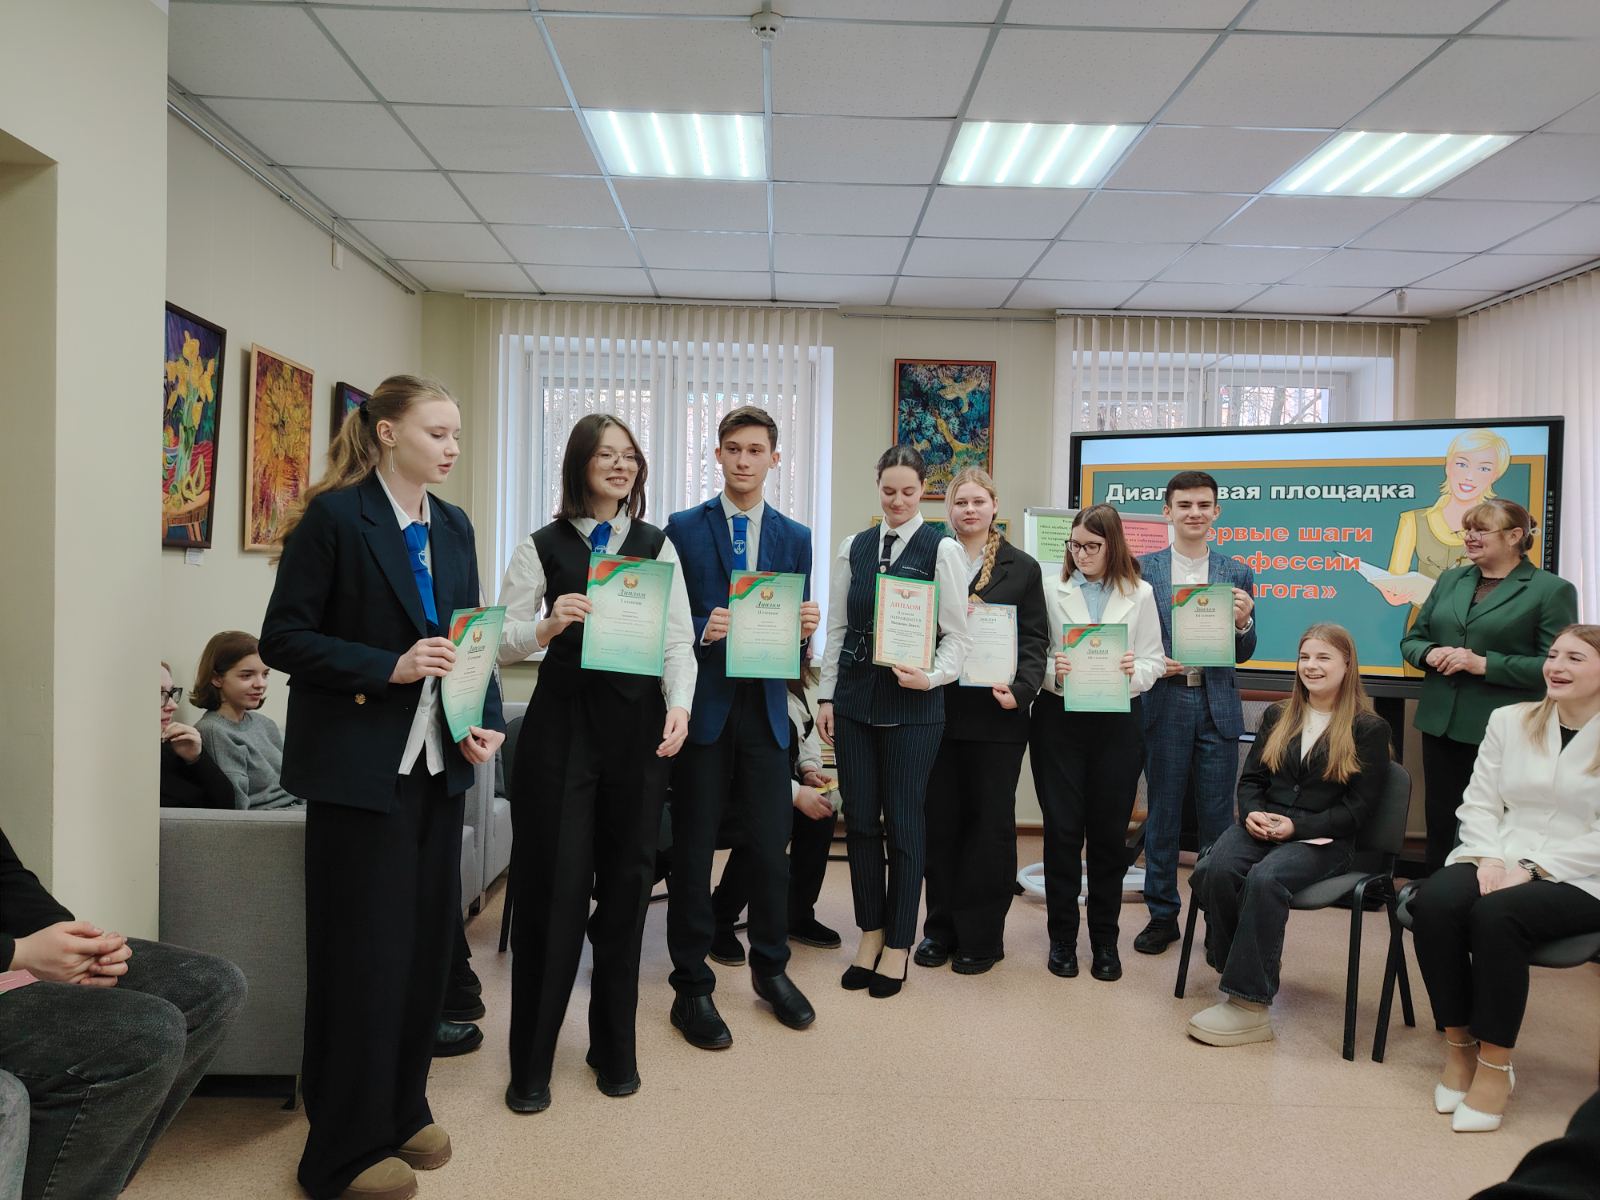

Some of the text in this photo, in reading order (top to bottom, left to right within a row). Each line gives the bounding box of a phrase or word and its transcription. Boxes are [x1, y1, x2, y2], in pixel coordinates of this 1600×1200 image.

[1105, 482, 1415, 504] Диалвая площадка
[1205, 527, 1373, 545] ервые шаги
[1231, 551, 1361, 574] фессии
[1252, 583, 1337, 599] гога»
